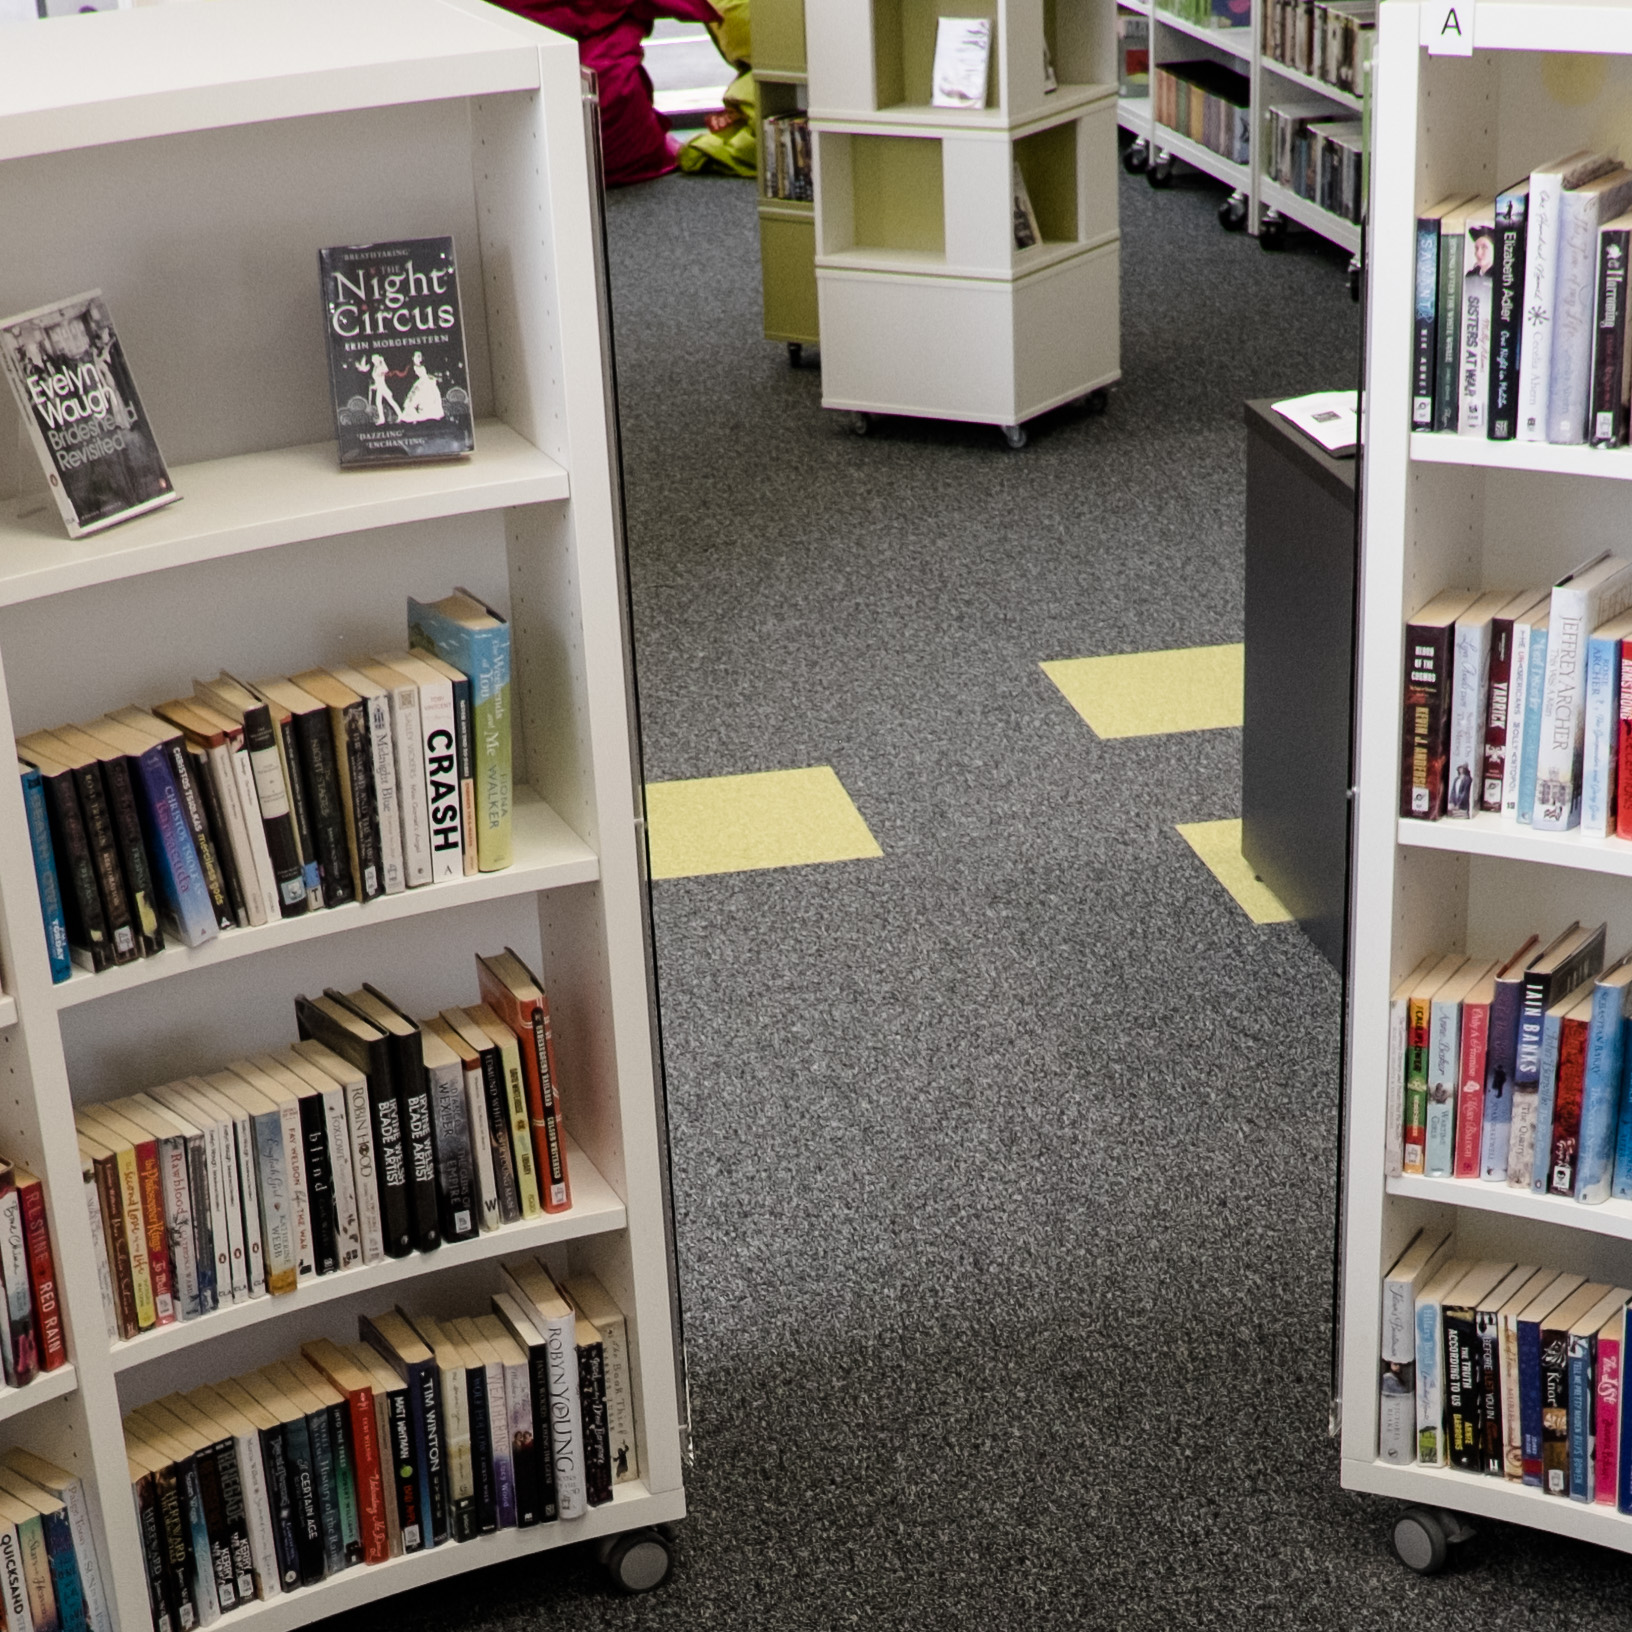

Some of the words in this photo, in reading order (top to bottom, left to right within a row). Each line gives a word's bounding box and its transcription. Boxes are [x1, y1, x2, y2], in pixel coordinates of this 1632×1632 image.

[1441, 7, 1462, 36] A
[1503, 232, 1517, 288] Elizabeth
[333, 260, 447, 308] Night
[1500, 288, 1514, 322] Adler
[332, 304, 455, 337] Circus
[345, 341, 369, 351] ERIN
[373, 334, 449, 348] MORGENSTERN
[26, 363, 99, 406] Evelyn
[37, 384, 117, 429] Waugh
[48, 400, 138, 451] Brideshed
[56, 434, 126, 471] Revisited
[1559, 615, 1580, 683] JEFFREY
[1490, 682, 1509, 730] YARRICK
[1552, 683, 1577, 751] ARCHER
[427, 729, 460, 852] CRASH
[488, 764, 500, 829] WALKER
[1523, 984, 1544, 1017] IAIN
[1519, 1023, 1540, 1073] BANKS
[378, 1101, 393, 1144] BLADE
[408, 1097, 422, 1139] BLADE
[438, 1082, 454, 1137] WEXLER
[308, 1132, 328, 1192] blind
[384, 1147, 399, 1187] ARTIST
[413, 1142, 428, 1182] ARTIST
[447, 1159, 460, 1204] EMPIRE
[38, 1281, 53, 1313] RED
[43, 1314, 62, 1354] RAIN
[548, 1327, 566, 1384] ROBYN
[1447, 1328, 1461, 1385] ACCORDING
[422, 1378, 435, 1404] TIM
[425, 1407, 440, 1473] WINTON
[549, 1390, 575, 1473] YOUNG
[0, 1533, 24, 1615] QUICKSAND
